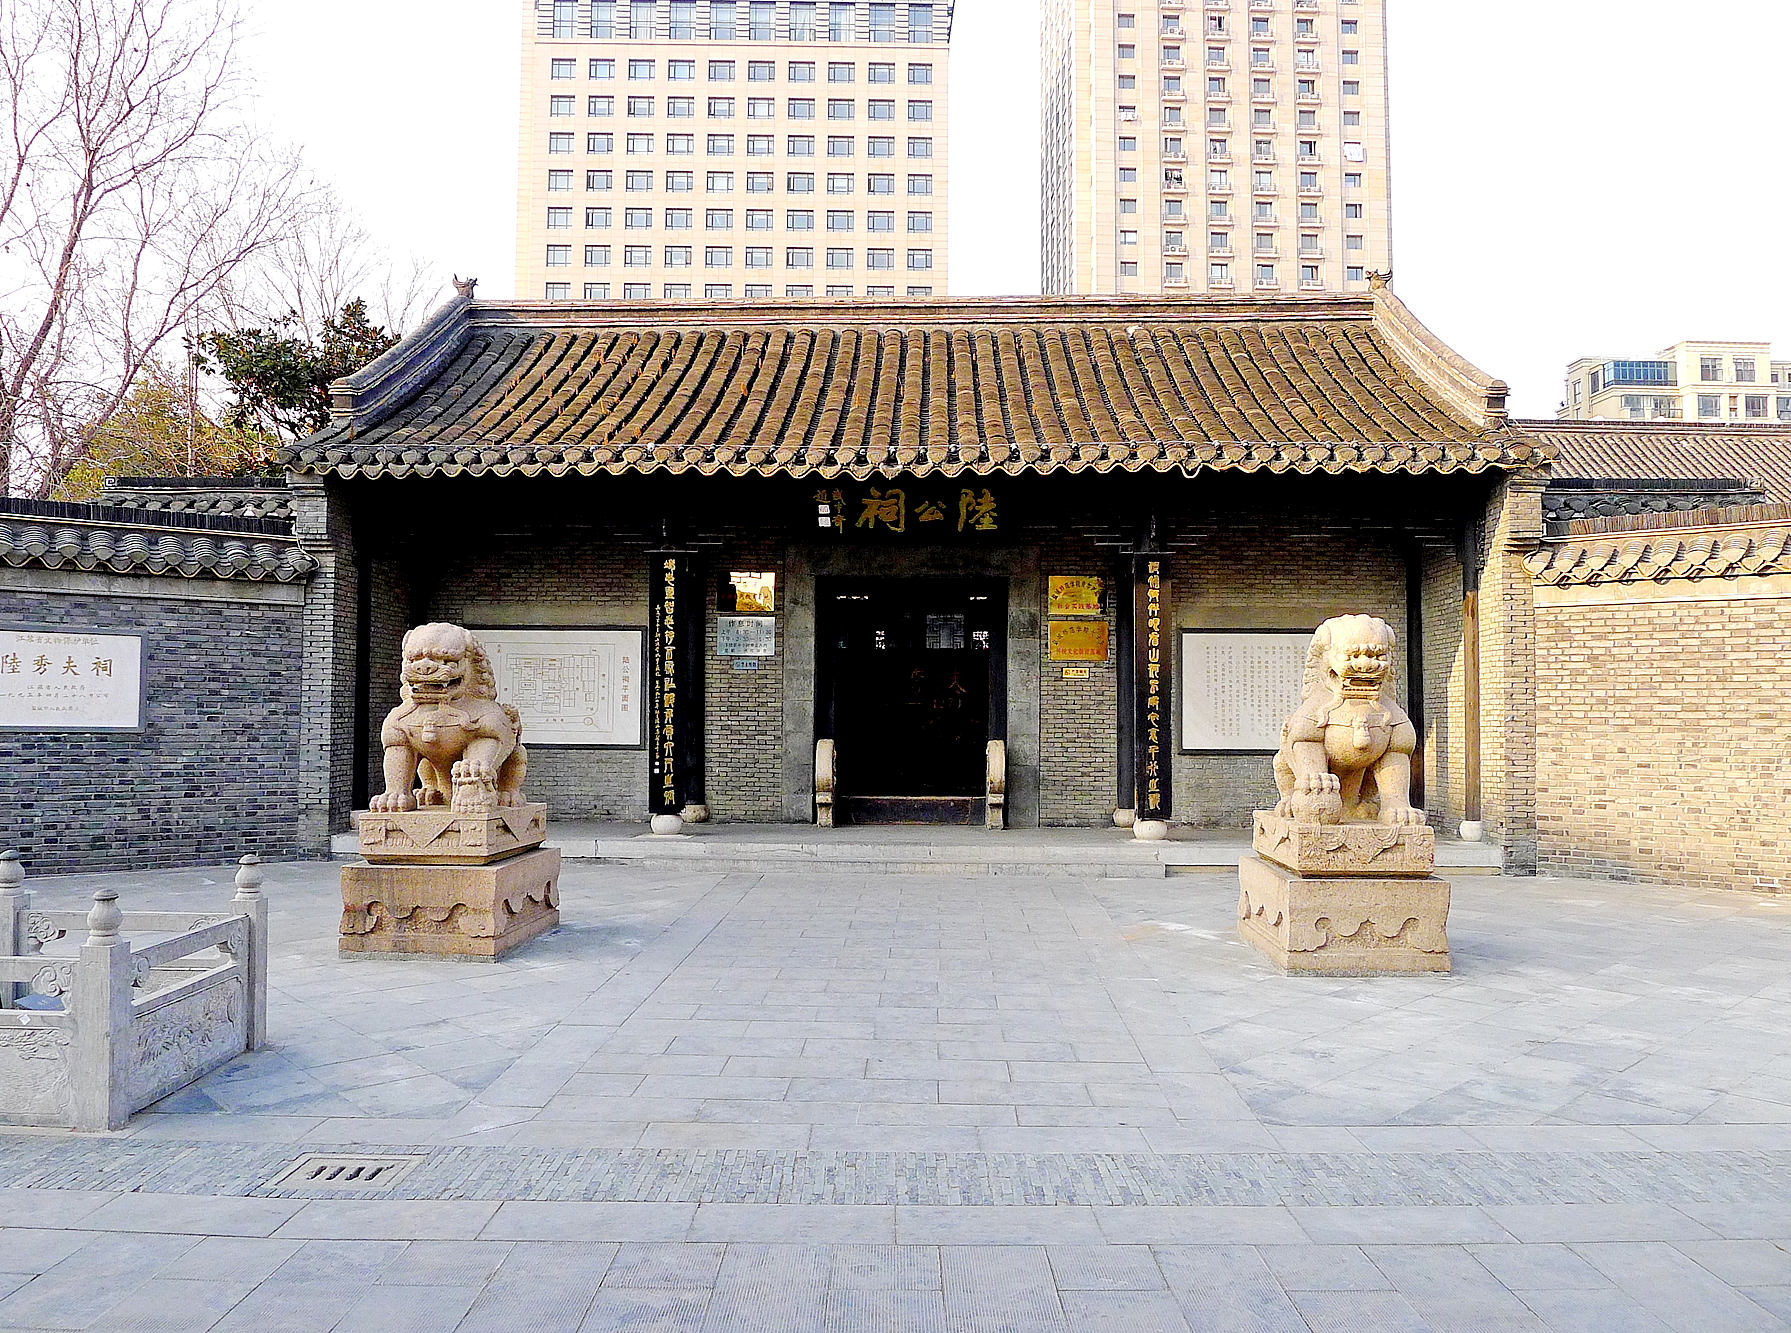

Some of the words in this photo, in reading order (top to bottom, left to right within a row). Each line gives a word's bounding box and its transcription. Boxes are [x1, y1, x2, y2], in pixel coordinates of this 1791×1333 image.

[728, 619, 763, 628] 作息时间
[15, 634, 100, 646] 江苏省文物保护单位
[0, 652, 114, 678] 陸秀夫祠
